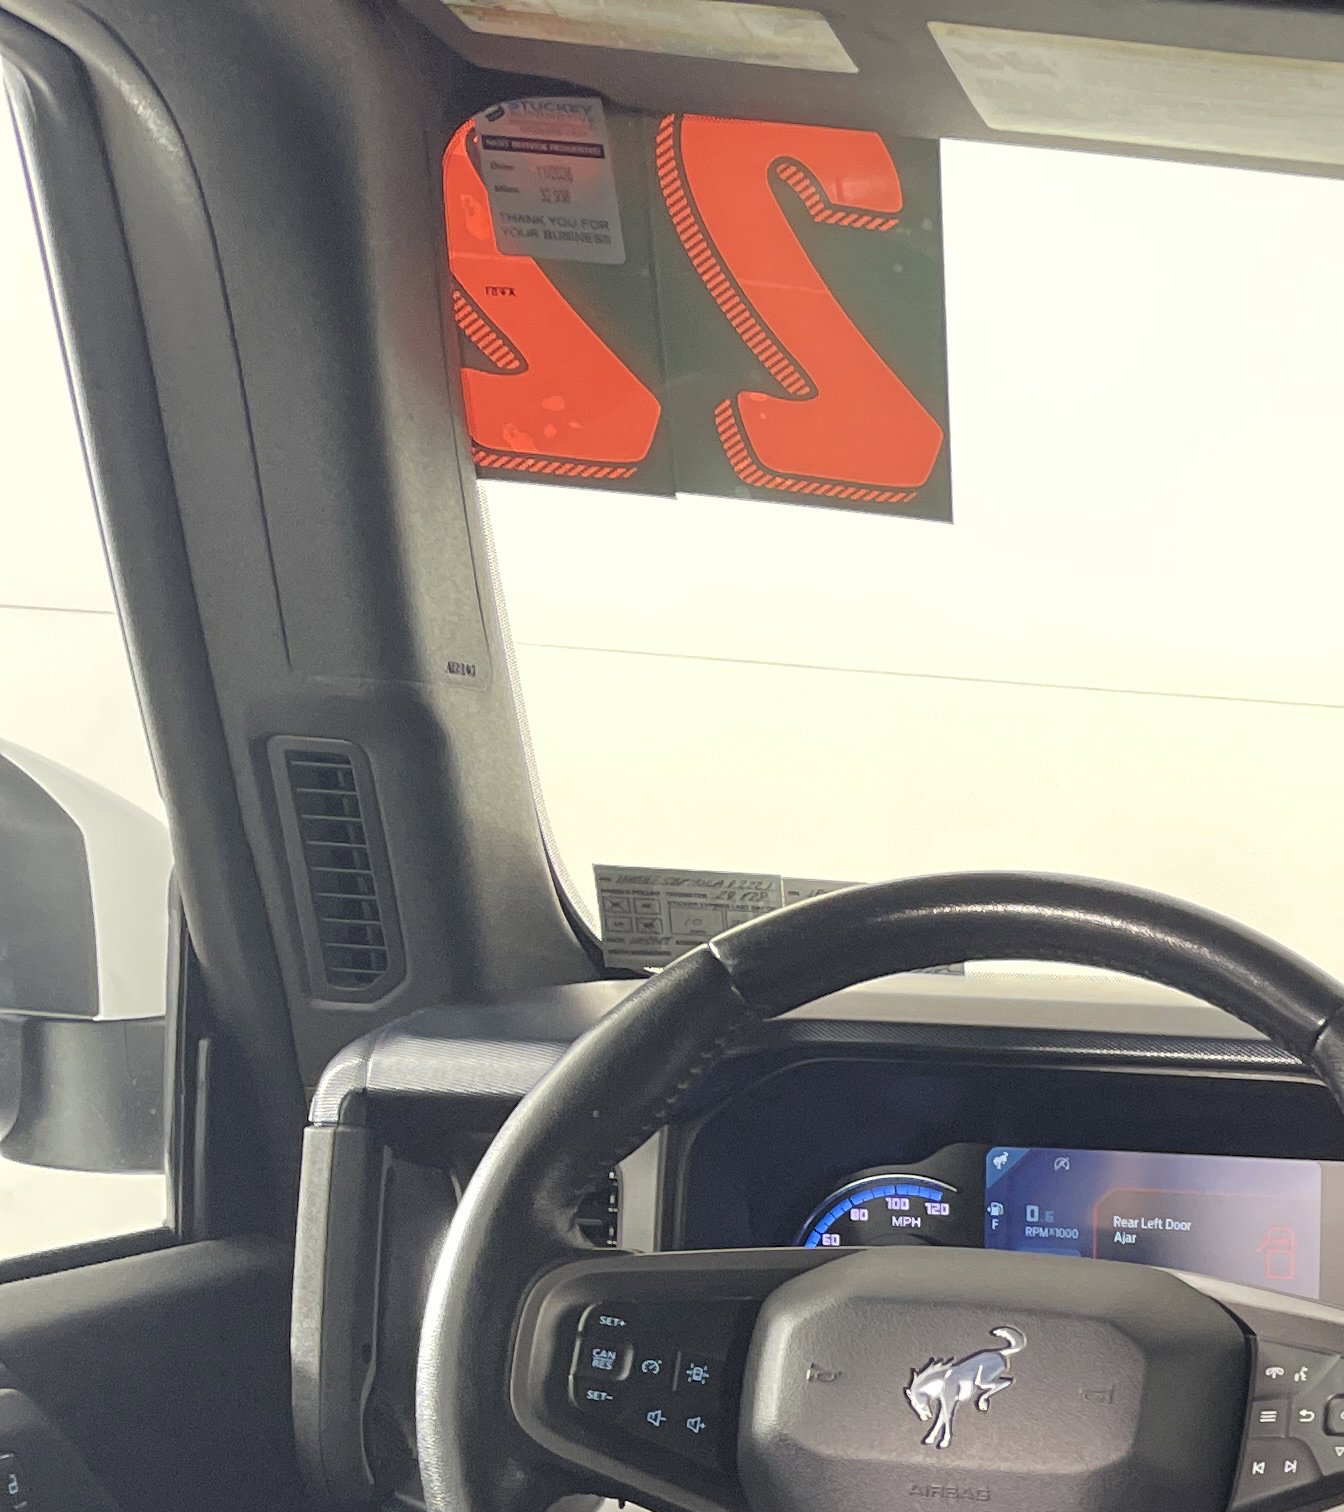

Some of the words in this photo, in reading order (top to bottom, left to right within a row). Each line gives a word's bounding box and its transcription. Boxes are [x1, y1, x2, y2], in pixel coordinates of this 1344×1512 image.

[499, 212, 546, 225] THANK
[549, 215, 578, 228] YOU
[581, 218, 610, 231] FOR
[886, 1197, 910, 1211] 100
[925, 1202, 950, 1216] 120
[892, 1215, 921, 1228] MPH
[1113, 1216, 1138, 1229] Rear
[1141, 1217, 1163, 1230] Left
[1165, 1218, 1191, 1231] Door
[1114, 1231, 1136, 1245] Ajar
[592, 1348, 617, 1360] CAN
[592, 1359, 613, 1370] RES
[908, 1483, 991, 1502] AIRBAG
